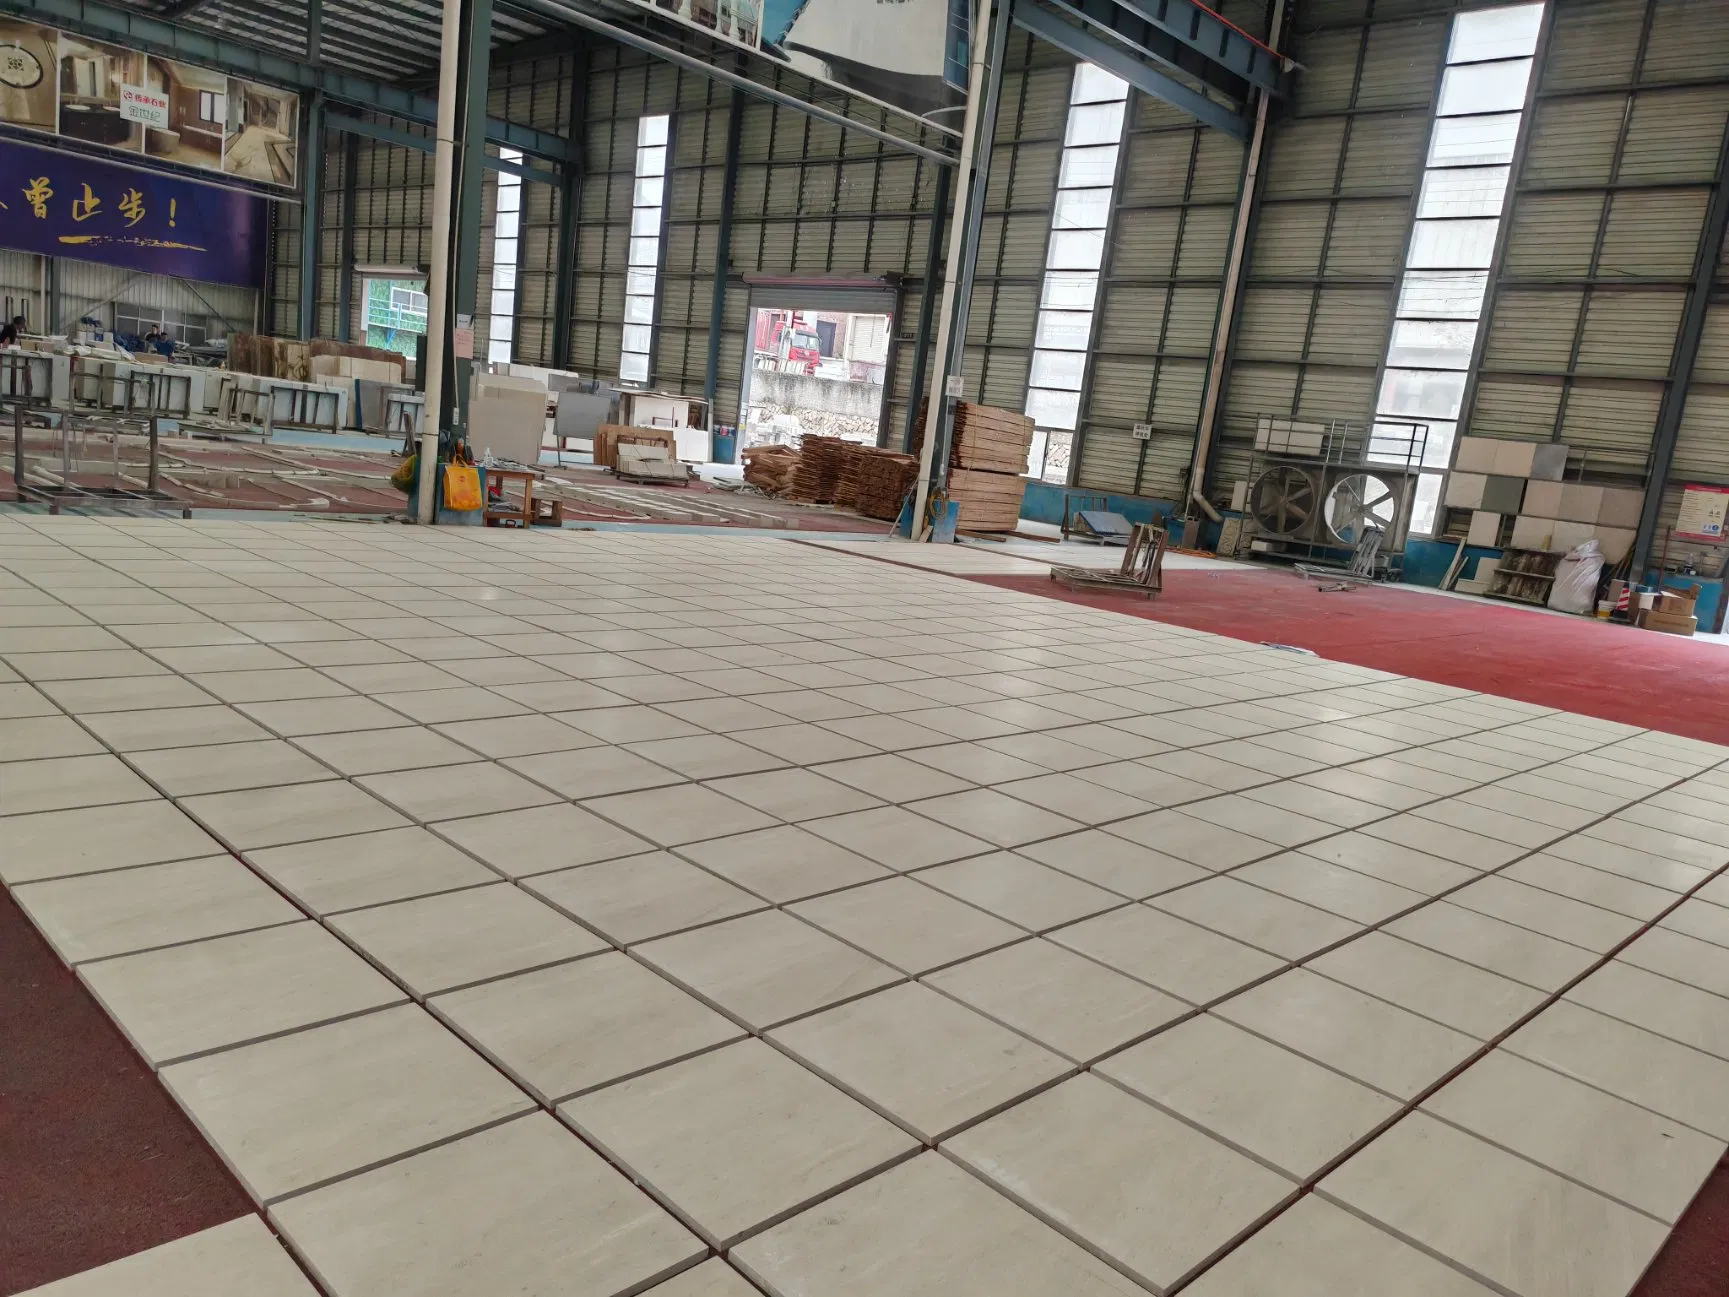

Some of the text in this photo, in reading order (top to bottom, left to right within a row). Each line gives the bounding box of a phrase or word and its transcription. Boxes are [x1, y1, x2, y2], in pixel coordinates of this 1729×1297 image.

[129, 105, 161, 123] 金世纪
[0, 176, 177, 228] 曾止步！
